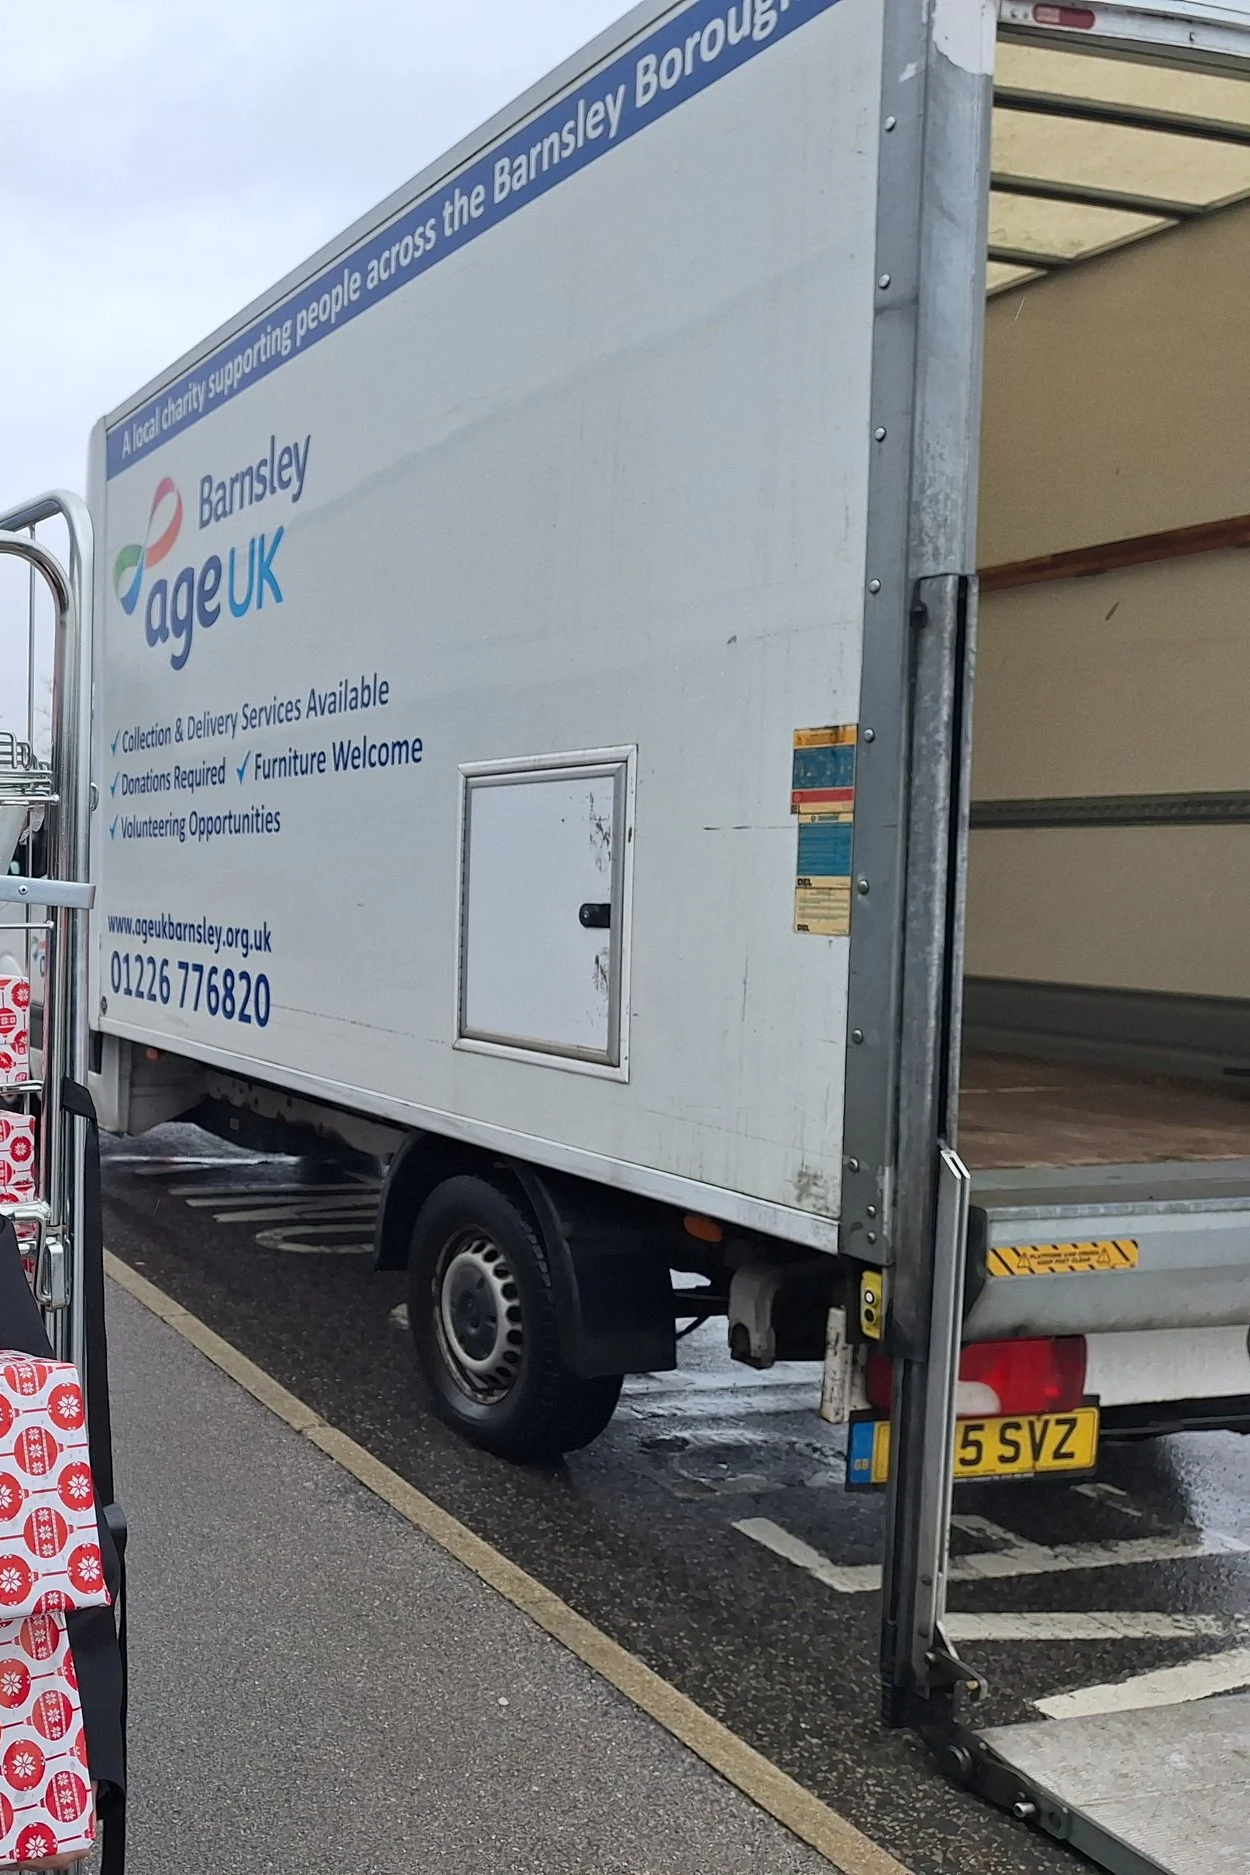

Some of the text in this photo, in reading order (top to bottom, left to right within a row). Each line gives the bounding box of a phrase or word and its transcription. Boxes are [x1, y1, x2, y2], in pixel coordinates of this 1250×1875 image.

[122, 0, 791, 459] A local charity supporting people across the Barnsley Boroug
[199, 434, 311, 530] Barnsley
[122, 672, 389, 753] Collection & Delivery Services Available
[121, 757, 226, 796] Donations Required
[254, 735, 423, 781] Furniture Welcome
[120, 804, 281, 843] Volunteering Opportunities
[107, 912, 272, 959] www.ageukbarnsley.org.uk
[111, 950, 271, 1028] 01226 776820
[997, 1418, 1078, 1464] SVZ
